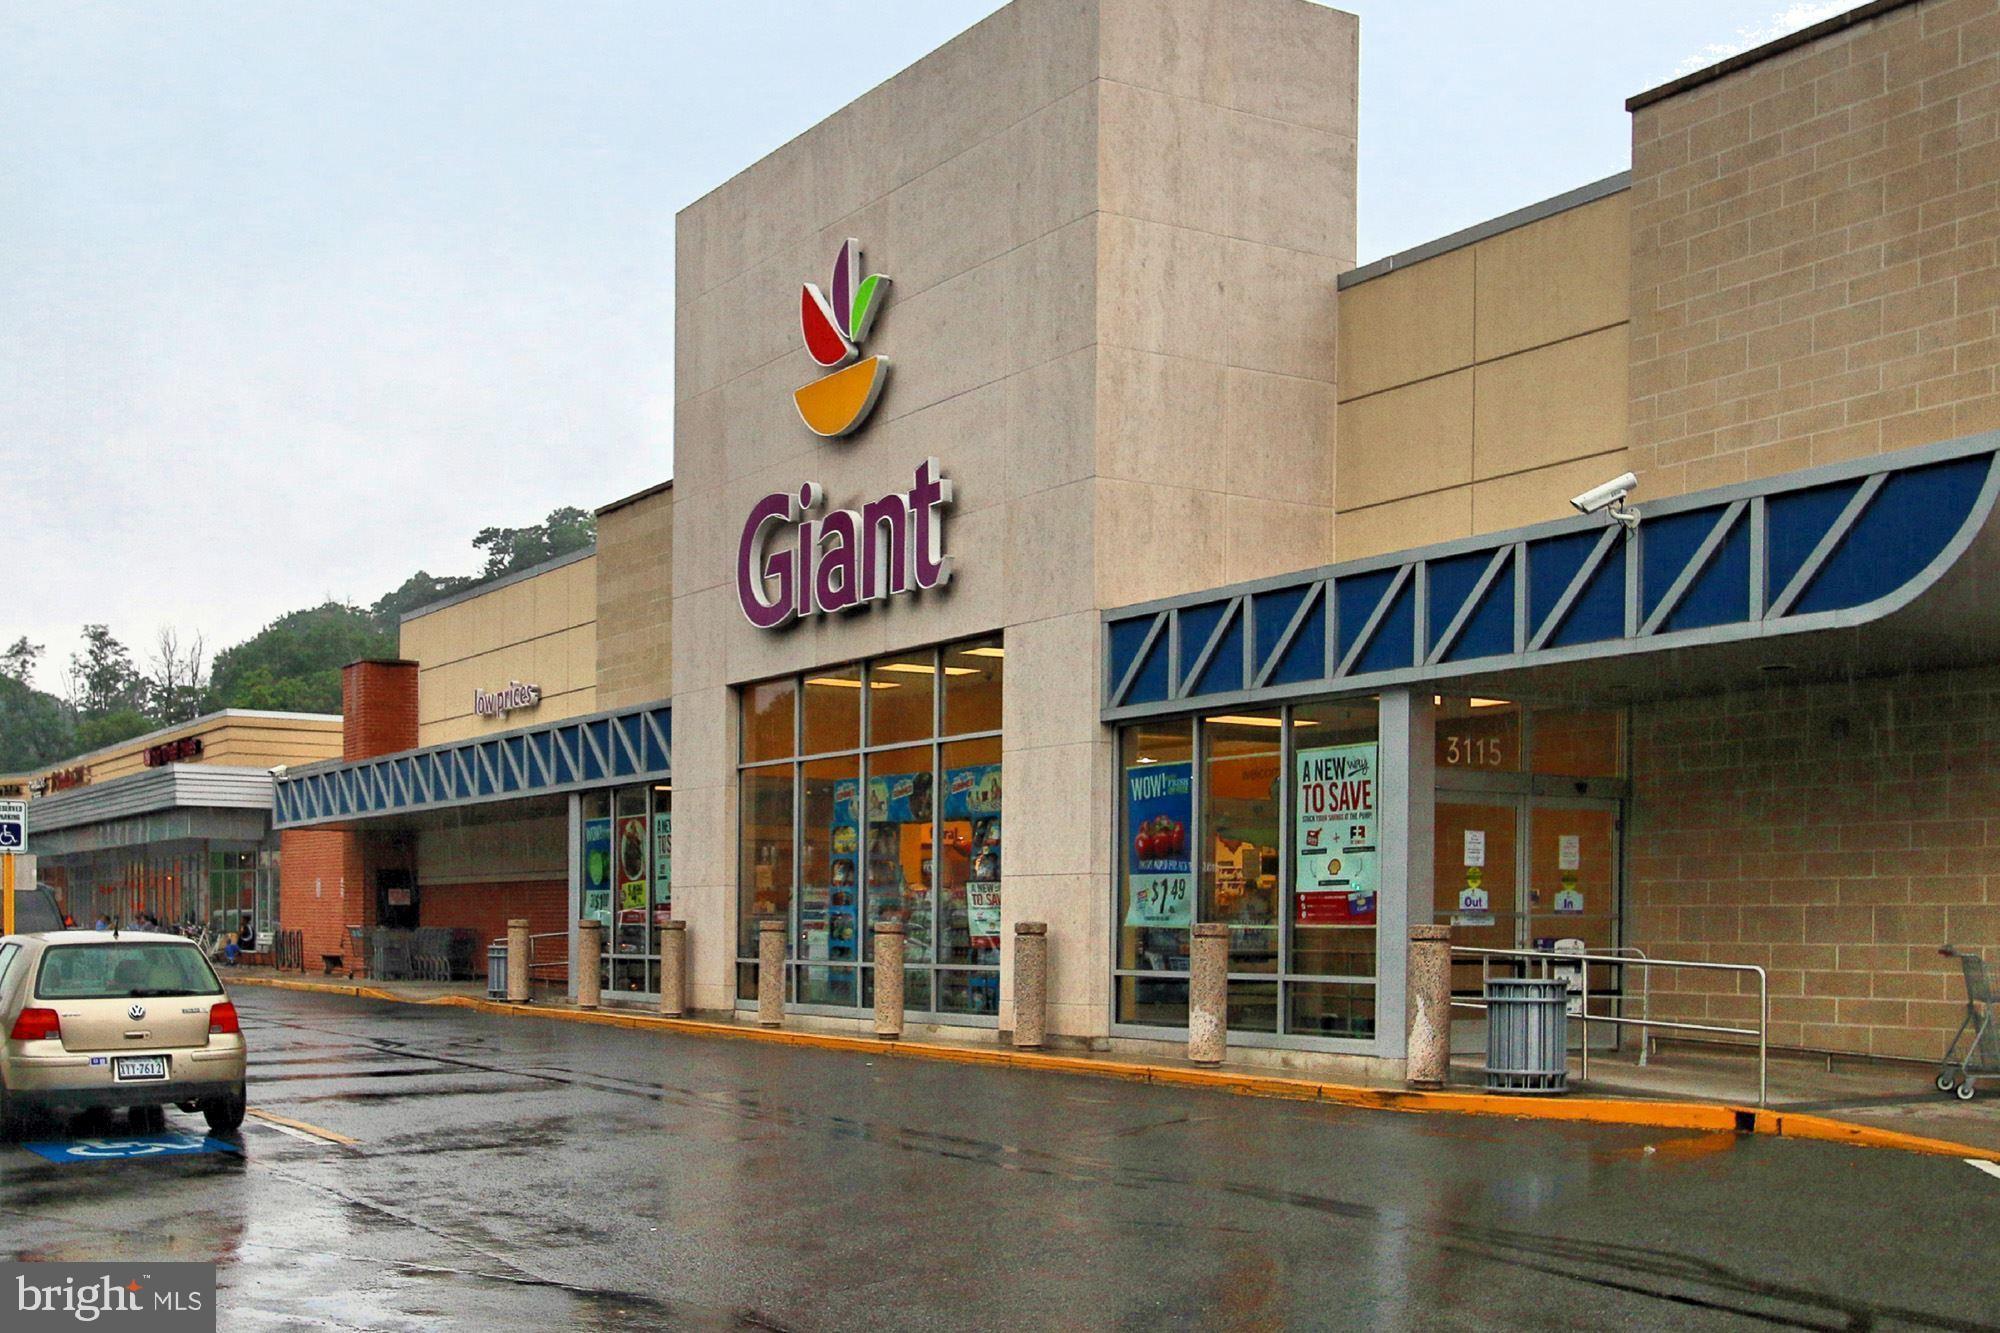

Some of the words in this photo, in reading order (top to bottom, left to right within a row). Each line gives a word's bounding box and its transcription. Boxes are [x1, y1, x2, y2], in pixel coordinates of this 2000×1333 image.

[736, 456, 953, 628] Giant
[474, 688, 496, 716] low
[497, 681, 540, 720] prices
[1447, 736, 1502, 766] 3115
[1303, 760, 1311, 782] A
[1314, 757, 1346, 781] NEW
[1347, 757, 1369, 777] way
[1131, 773, 1166, 801] WOW!
[1302, 783, 1324, 813] TO
[1329, 779, 1372, 812] SAVE
[972, 894, 982, 905] TO
[986, 893, 1001, 905] SAV
[1464, 896, 1482, 907] Out
[1564, 898, 1574, 909] In
